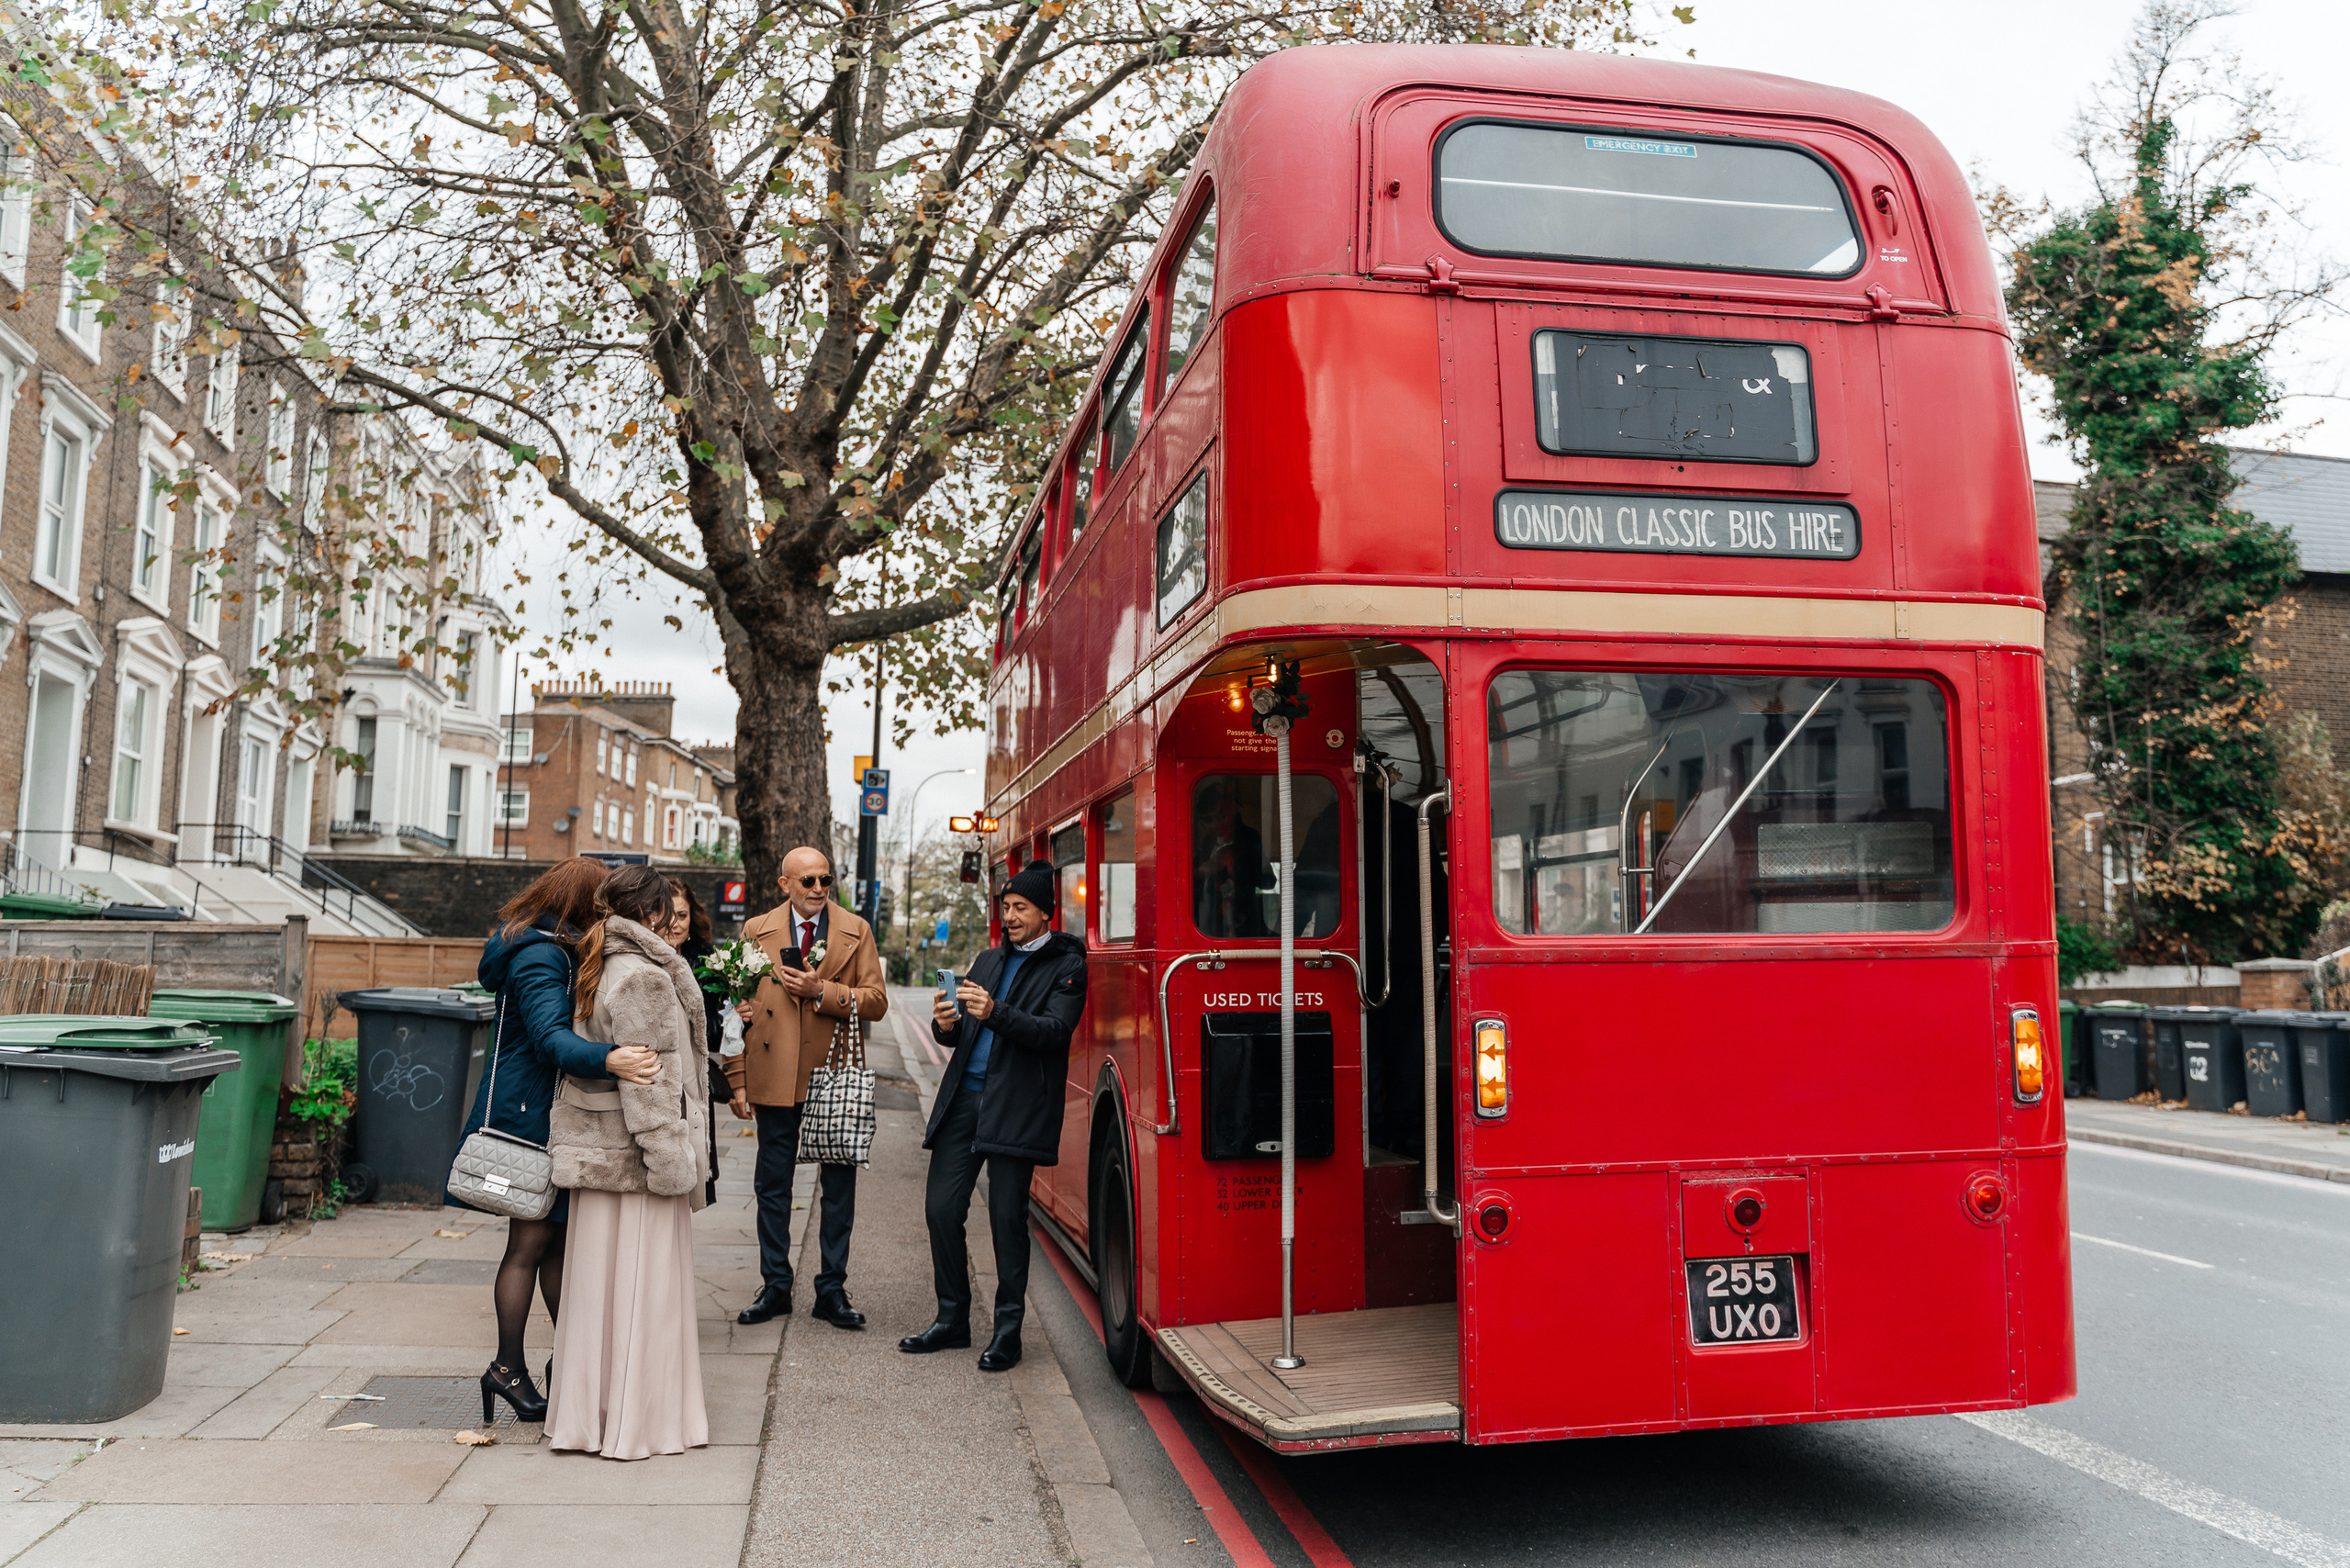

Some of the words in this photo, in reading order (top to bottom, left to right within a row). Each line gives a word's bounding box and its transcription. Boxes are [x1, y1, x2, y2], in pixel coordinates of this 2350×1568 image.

[1592, 139, 1661, 152] EMERGENCY
[1663, 145, 1689, 154] EXIT
[1502, 504, 1604, 544] LONDON
[1617, 508, 1717, 548] CLASSIC
[1729, 510, 1777, 550] BUS
[1789, 512, 1844, 553] HIRE
[1226, 729, 1264, 737] Passenge
[867, 797, 882, 807] 30
[1203, 992, 1252, 1007] USED
[1257, 992, 1324, 1006] TICETS
[1216, 1177, 1227, 1187] 72
[1232, 1175, 1298, 1186] PASSENGS
[1216, 1189, 1228, 1199] 32
[1233, 1187, 1271, 1198] LOWER
[1216, 1202, 1230, 1211] 40
[1233, 1200, 1267, 1211] UPPER
[1271, 1199, 1300, 1209] DK
[1706, 1261, 1777, 1297] 255
[1708, 1303, 1781, 1338] UXO
